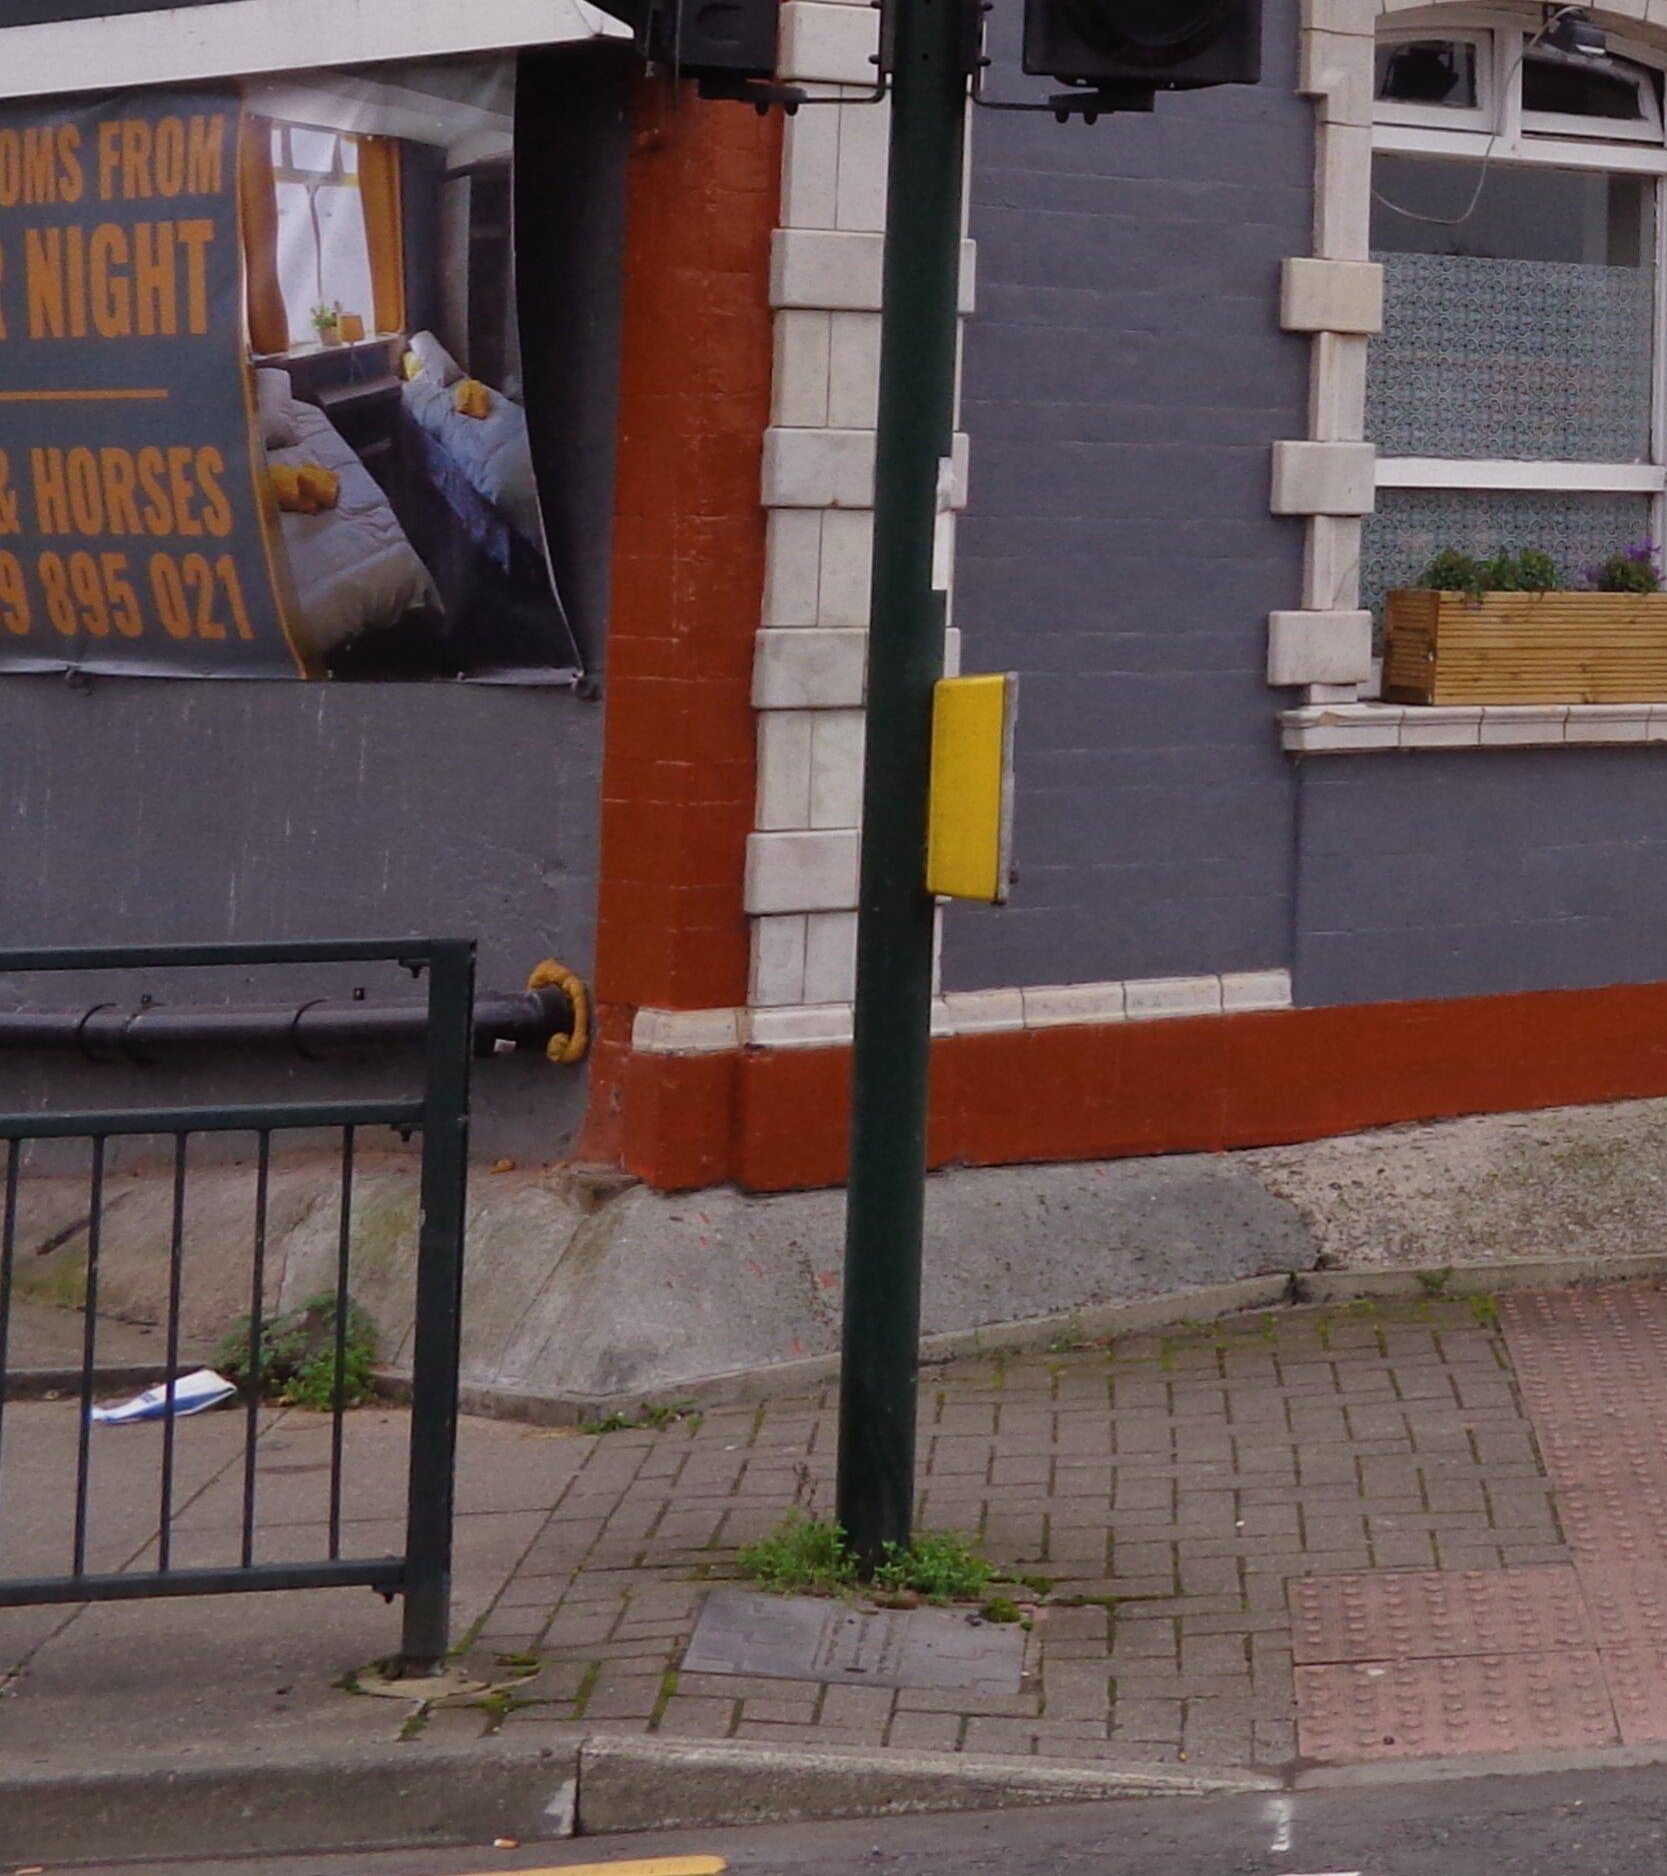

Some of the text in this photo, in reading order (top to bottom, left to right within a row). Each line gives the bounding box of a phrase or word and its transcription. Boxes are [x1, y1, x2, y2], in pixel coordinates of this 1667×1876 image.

[100, 113, 225, 200] FROM
[25, 218, 214, 339] NIGHT
[30, 446, 233, 537] HORSES
[38, 551, 144, 638] 895
[150, 552, 254, 640] 021
